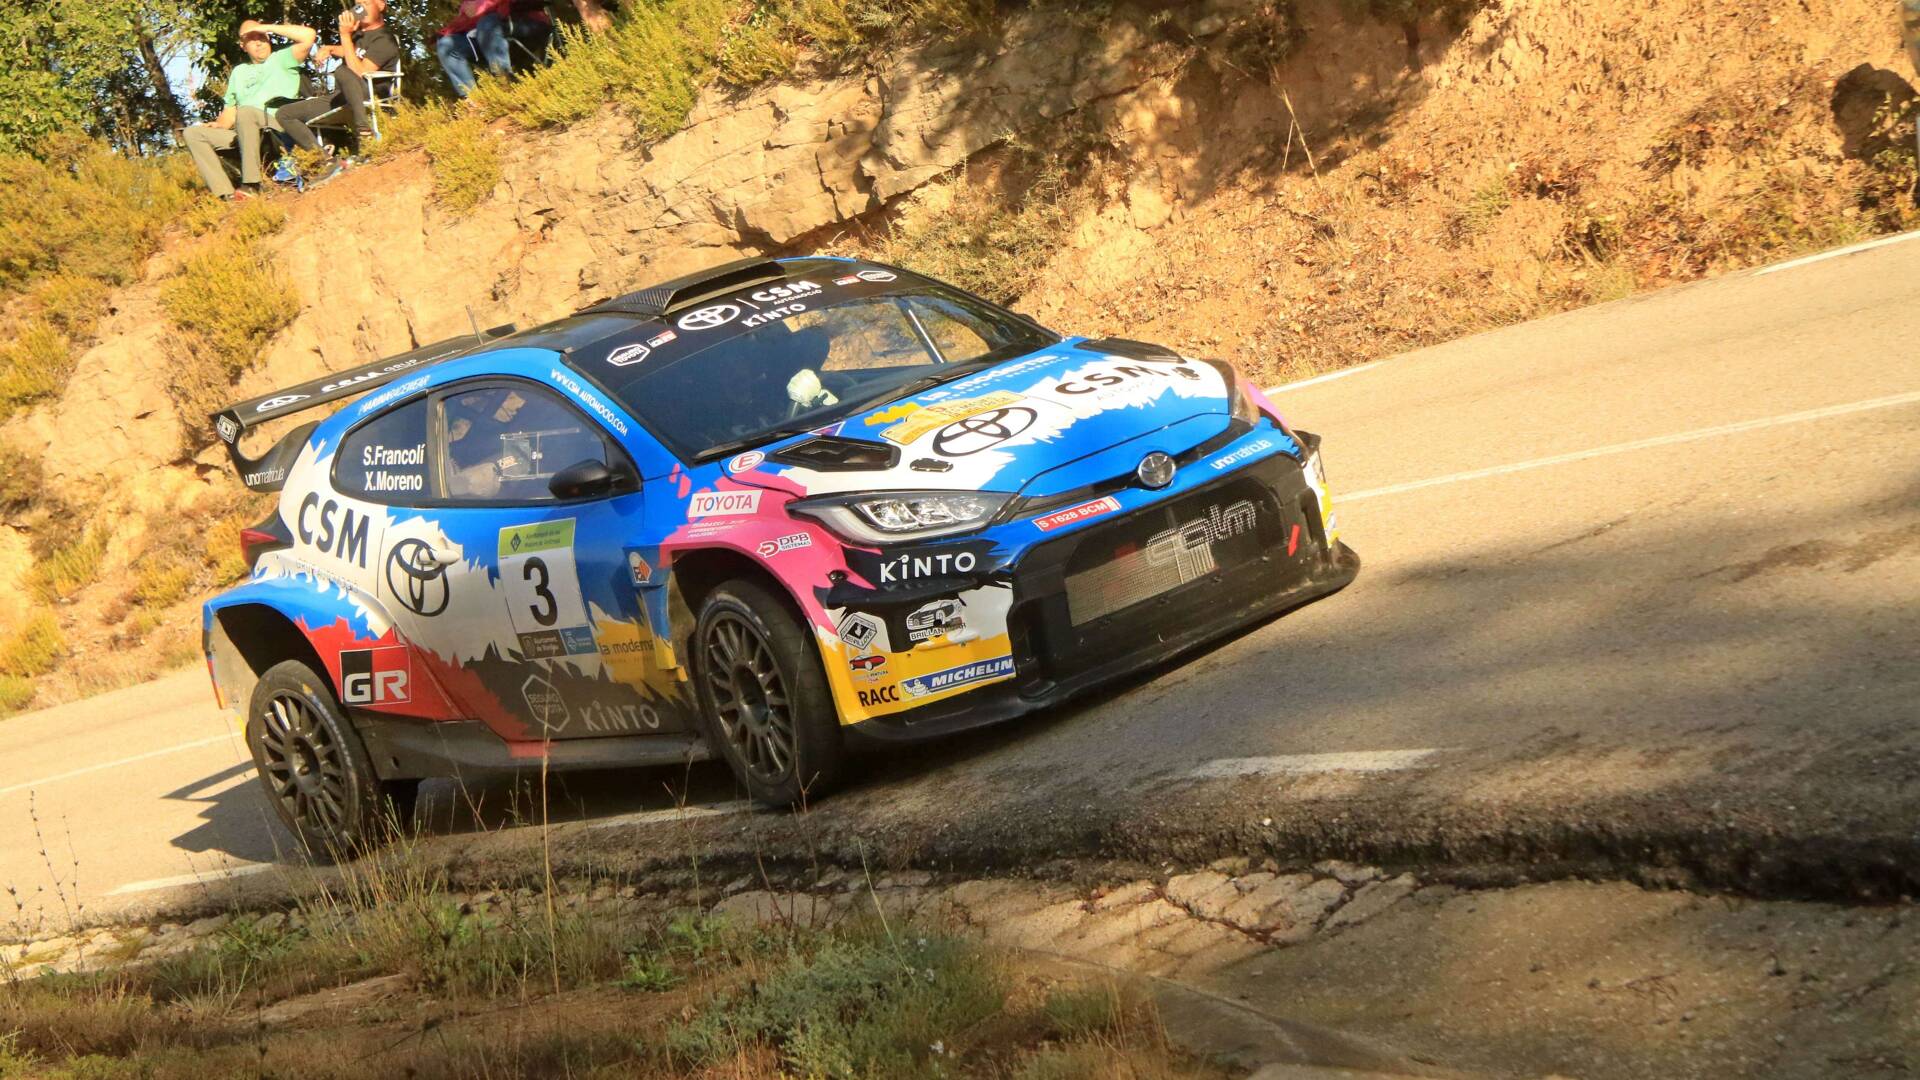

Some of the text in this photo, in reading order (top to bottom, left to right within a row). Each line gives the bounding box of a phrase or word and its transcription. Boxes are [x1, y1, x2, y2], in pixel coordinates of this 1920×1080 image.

[752, 280, 822, 302] CSM
[1055, 364, 1169, 395] CSM
[363, 443, 426, 466] S.Francolí
[738, 454, 754, 469] E
[364, 471, 423, 491] X.Moreno
[696, 494, 753, 512] TOYOTA
[298, 491, 370, 569] CSM
[779, 533, 809, 546] DPB
[523, 556, 559, 627] 3
[931, 658, 1013, 688] MICHELIN
[343, 669, 408, 704] GR
[858, 685, 899, 708] RACC
